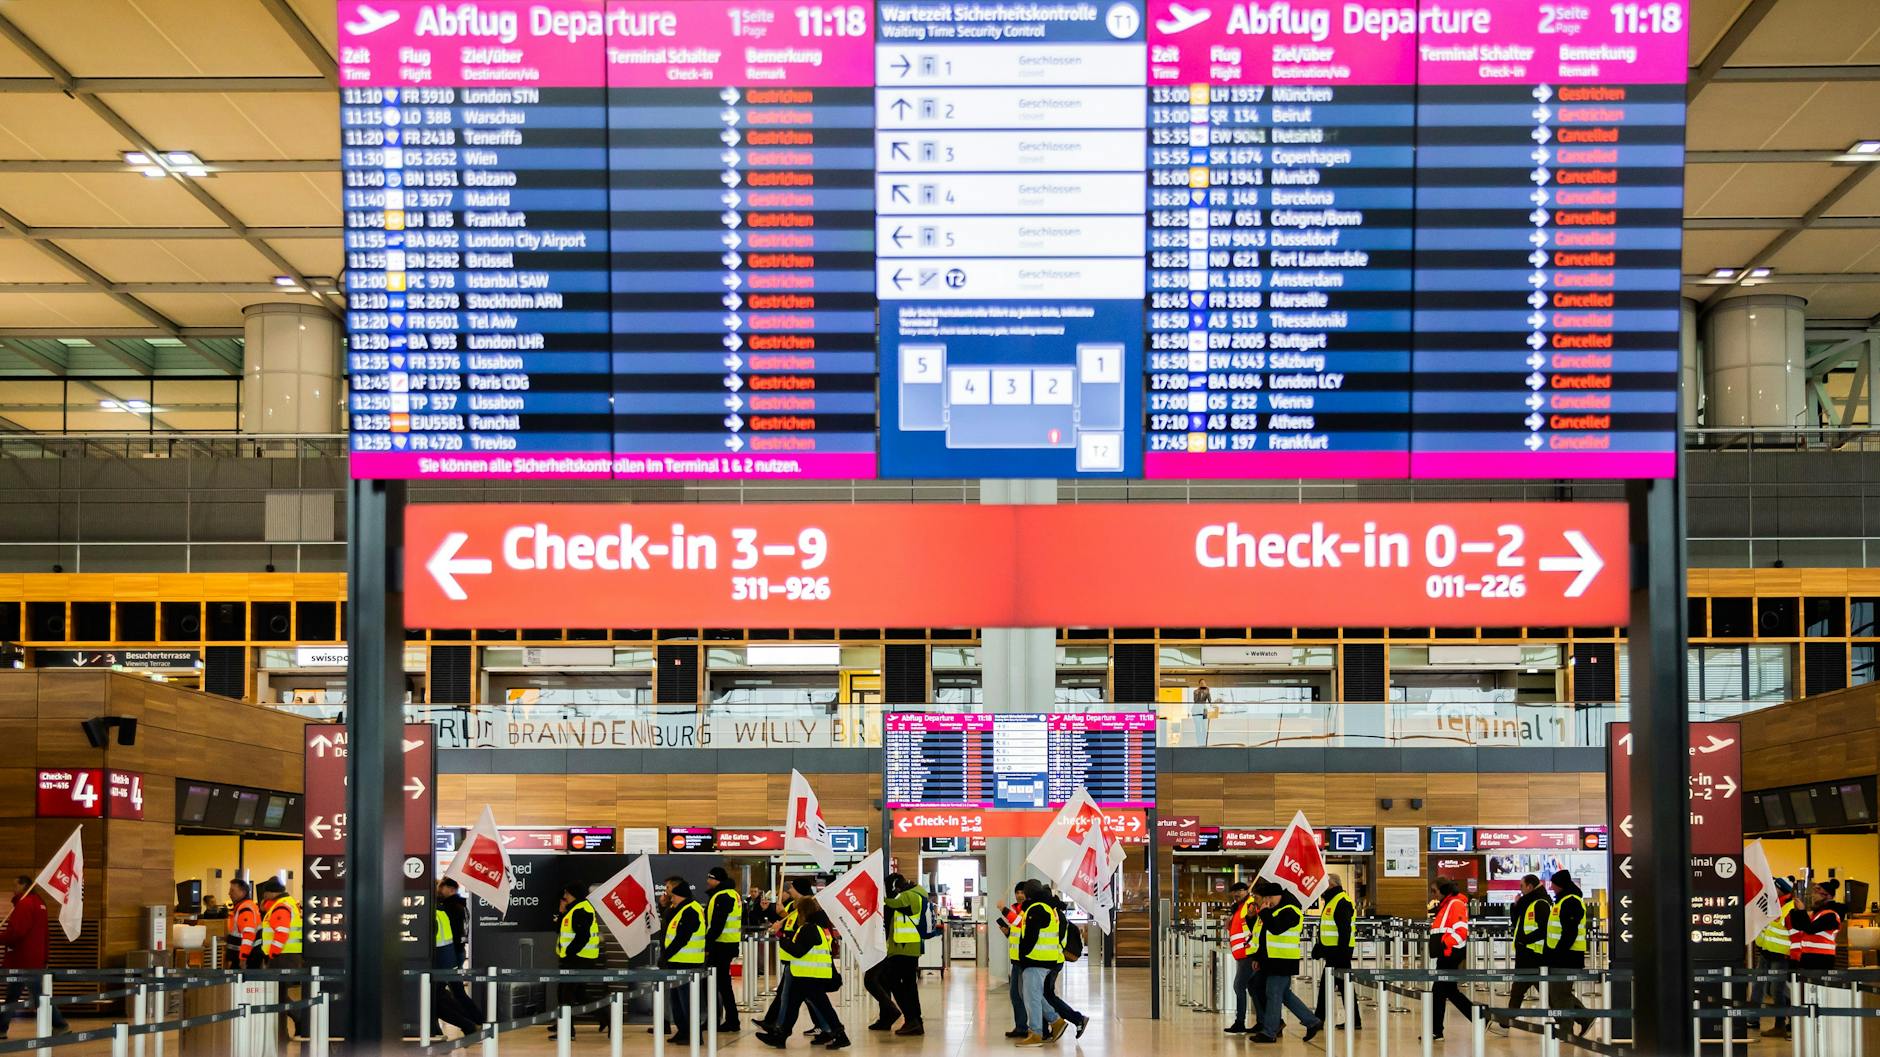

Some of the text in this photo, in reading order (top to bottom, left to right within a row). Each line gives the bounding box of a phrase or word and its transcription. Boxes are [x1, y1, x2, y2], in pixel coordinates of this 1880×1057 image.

[742, 10, 775, 24] Seite
[881, 6, 1098, 22] Wartezeit Sicherheitskontrolle
[1538, 7, 1555, 33] 2
[1556, 6, 1588, 20] Seite
[1610, 5, 1681, 33] 11:18
[415, 6, 677, 44] Abflug Departure
[727, 9, 741, 37] 1
[795, 8, 866, 37] 11:18
[1227, 4, 1490, 42] Abflug Departure
[1556, 22, 1580, 35] Page
[742, 26, 767, 39] Page
[882, 25, 1045, 40] Waiting Time Security Control
[342, 49, 370, 64] Zeit
[400, 49, 431, 66] Flug
[608, 49, 720, 64] Terminal Schalter
[746, 49, 822, 66] Bemerkung
[343, 67, 370, 81] Time
[401, 67, 432, 82] Flight
[667, 67, 713, 80] Check-in
[747, 67, 786, 80] Remark
[344, 89, 382, 104] 11:10
[462, 89, 512, 104] London
[346, 109, 382, 124] 11:15
[462, 109, 525, 124] Warschau
[463, 130, 522, 145] Teneriffa
[465, 151, 497, 165] Wien
[1271, 149, 1351, 166] Copenhagen
[463, 172, 517, 187] Bolzano
[1271, 171, 1320, 185] Munich
[465, 192, 510, 207] Madrid
[1271, 191, 1334, 206] Barcelona
[464, 213, 526, 228] Frankfurt
[466, 233, 586, 250] London City Airport
[1270, 252, 1368, 267] Fort Lauderdale
[1270, 272, 1344, 287] Amsterdam
[466, 294, 536, 309] Stockholm
[1270, 293, 1328, 308] Marseille
[468, 314, 517, 329] Tel Aviv
[467, 335, 516, 350] London
[469, 355, 523, 370] Lissabon
[917, 357, 928, 374] 5
[1269, 354, 1325, 371] Salzburg
[468, 375, 501, 390] Paris
[964, 378, 1058, 395] 4 3 2
[1269, 374, 1317, 389] London
[1268, 394, 1314, 409] Vienna
[470, 415, 520, 430] Funchal
[1268, 415, 1314, 429] Athens
[470, 435, 516, 450] Treviso
[1268, 435, 1328, 449] Frankfurt
[502, 523, 716, 571] Check-in
[1195, 521, 1410, 569] Check-in
[125, 652, 191, 661] Besucherterrasse
[311, 653, 348, 665] swisspo
[1250, 650, 1278, 658] WeWatch
[1063, 714, 1116, 722] Abflug Departure
[735, 719, 817, 743] WILLY
[71, 772, 98, 808] 4
[130, 776, 143, 811] 4
[914, 815, 959, 826] Check-in
[406, 862, 421, 874] T2
[1718, 863, 1733, 873] T2
[1548, 1009, 1562, 1017] BER
[1728, 1009, 1741, 1017] BER
